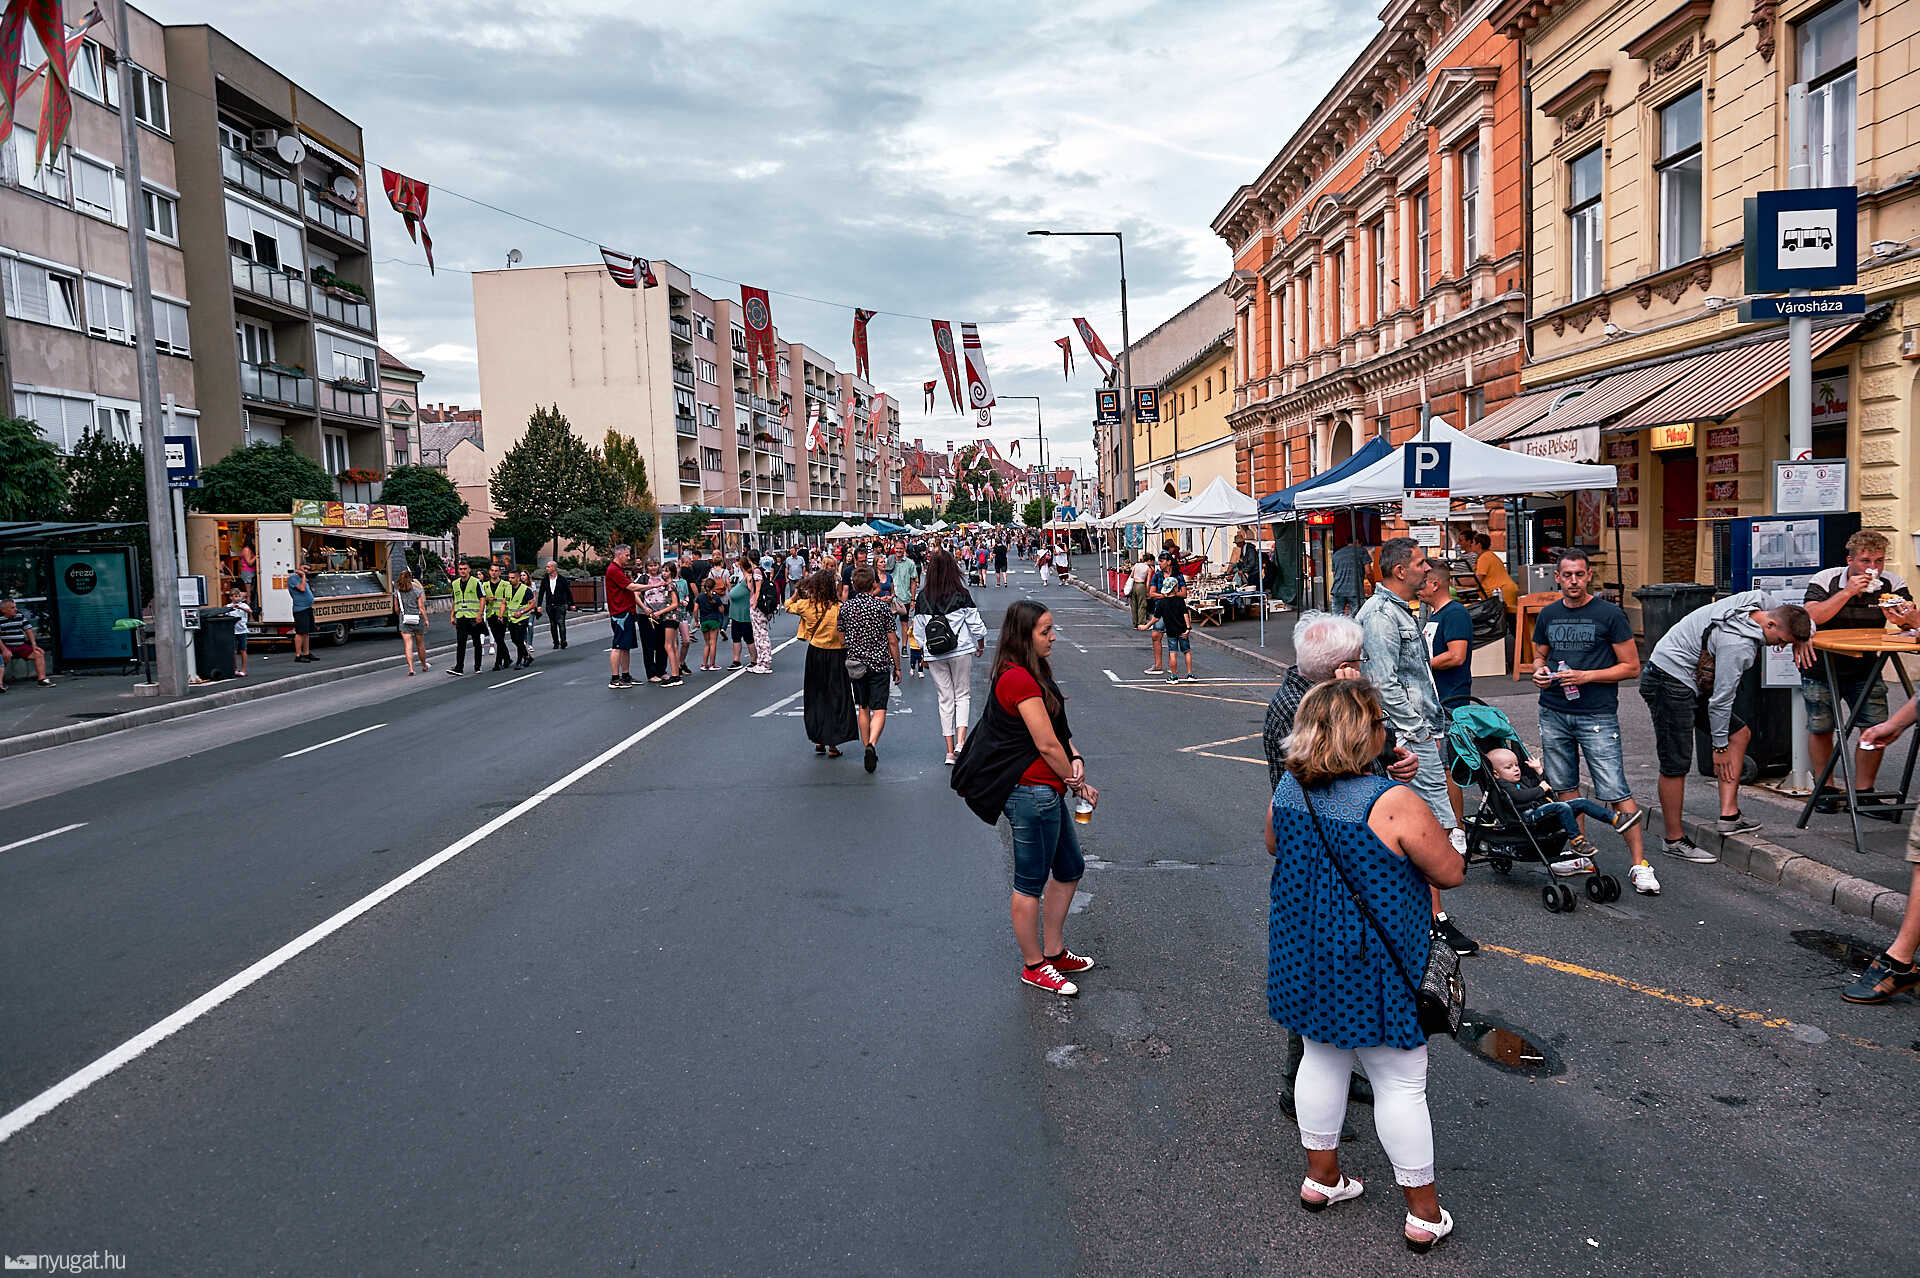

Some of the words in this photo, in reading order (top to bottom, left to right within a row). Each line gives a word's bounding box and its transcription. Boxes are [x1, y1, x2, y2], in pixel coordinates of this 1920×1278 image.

[1775, 299, 1843, 314] Városháza
[1526, 441, 1548, 456] Friss
[1414, 446, 1440, 485] P
